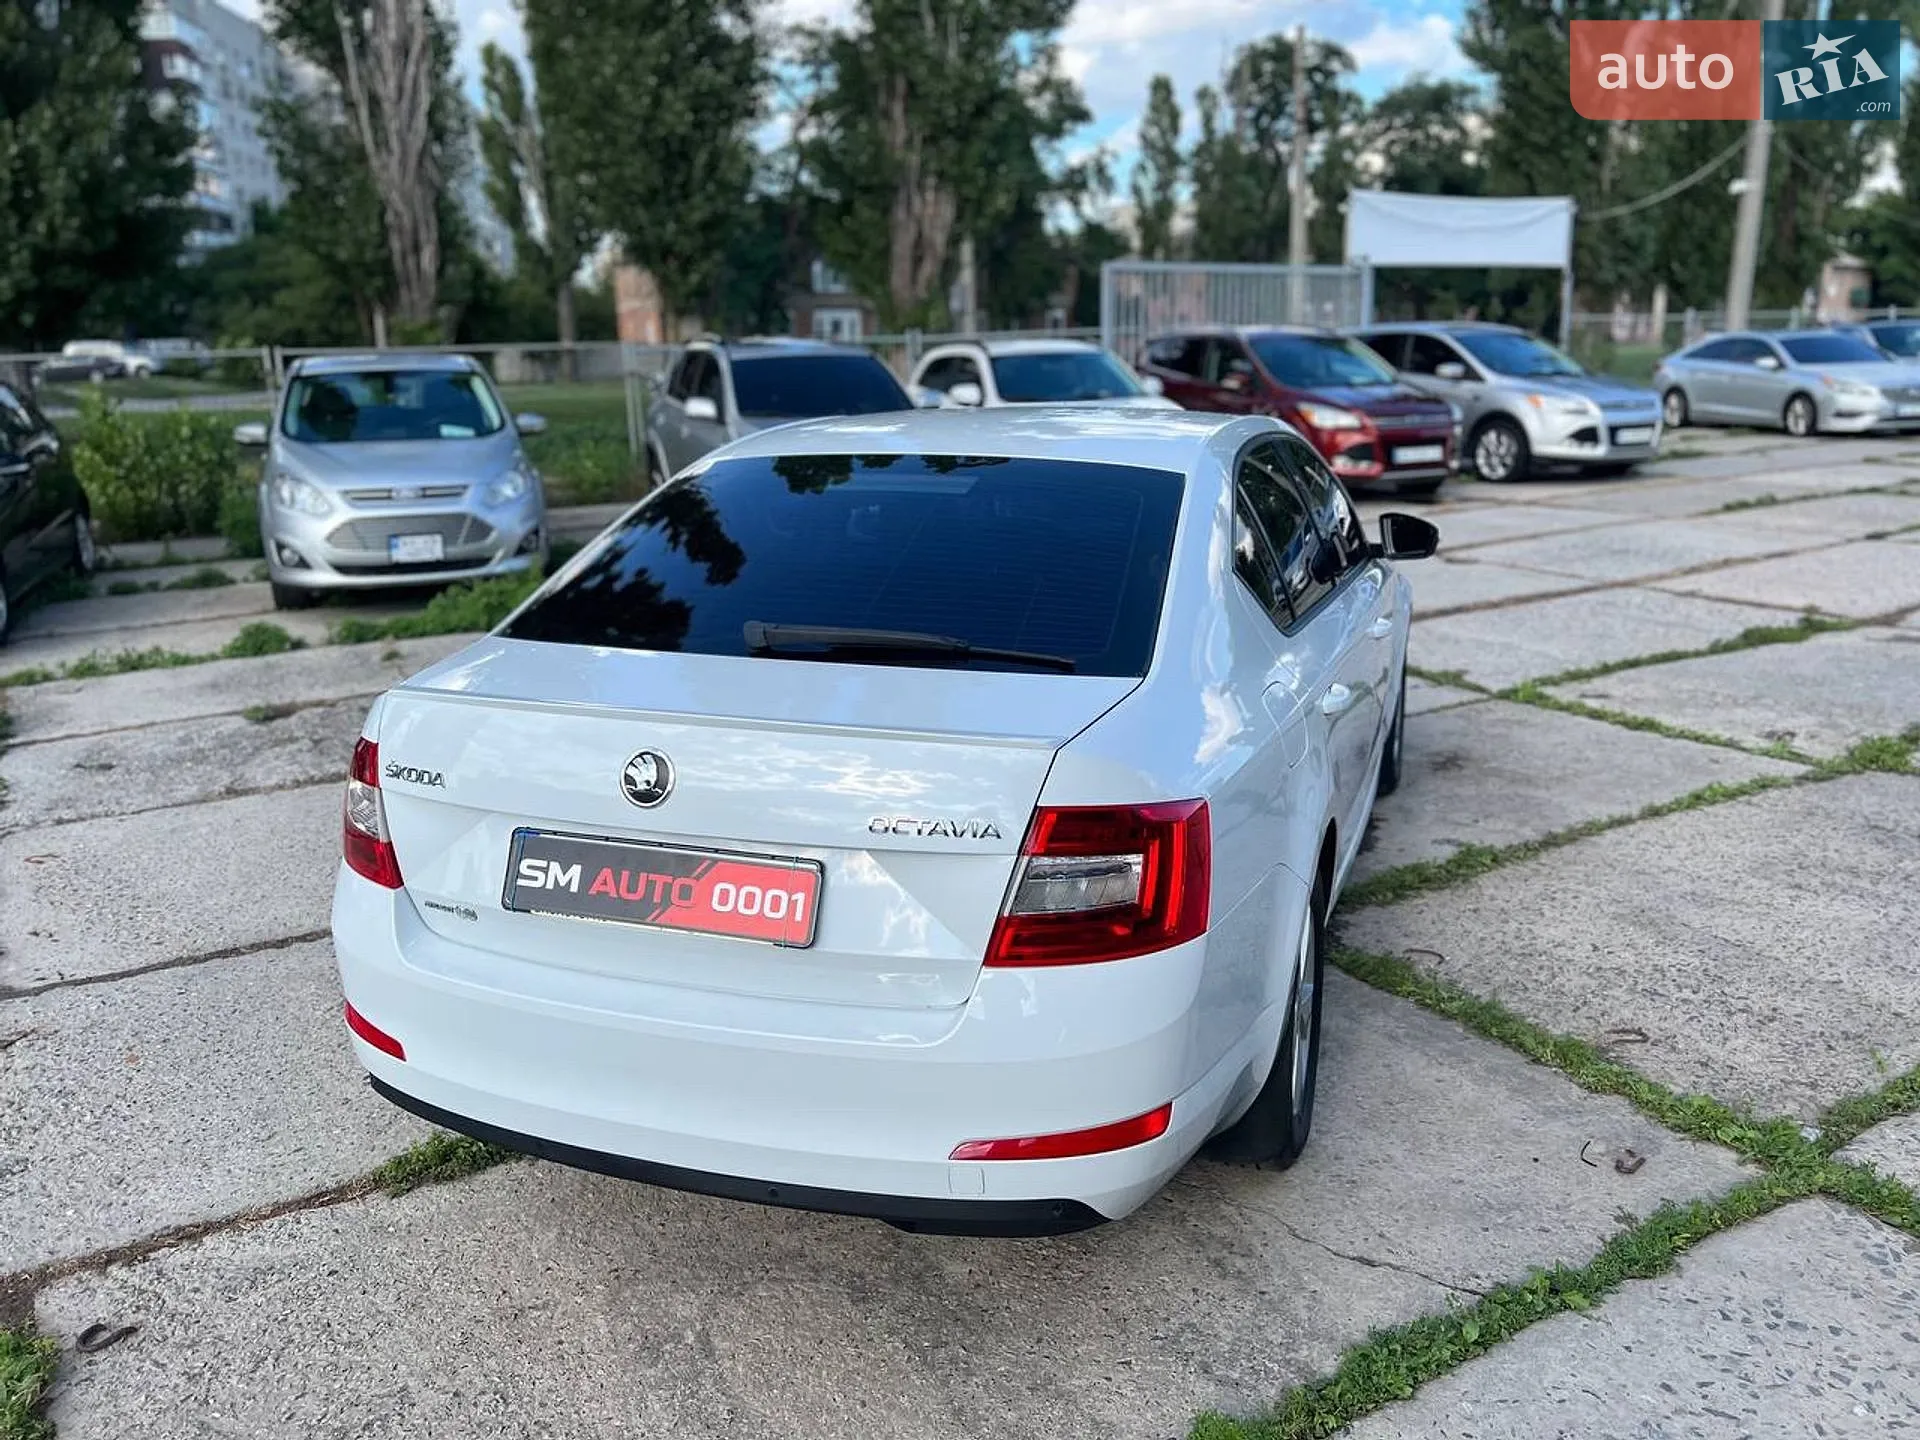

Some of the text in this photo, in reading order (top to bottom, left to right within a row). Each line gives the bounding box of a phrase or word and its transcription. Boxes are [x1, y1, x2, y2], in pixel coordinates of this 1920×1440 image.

[868, 818, 1003, 840] OCTAVIA
[516, 858, 806, 922] SM AUTO 0001
